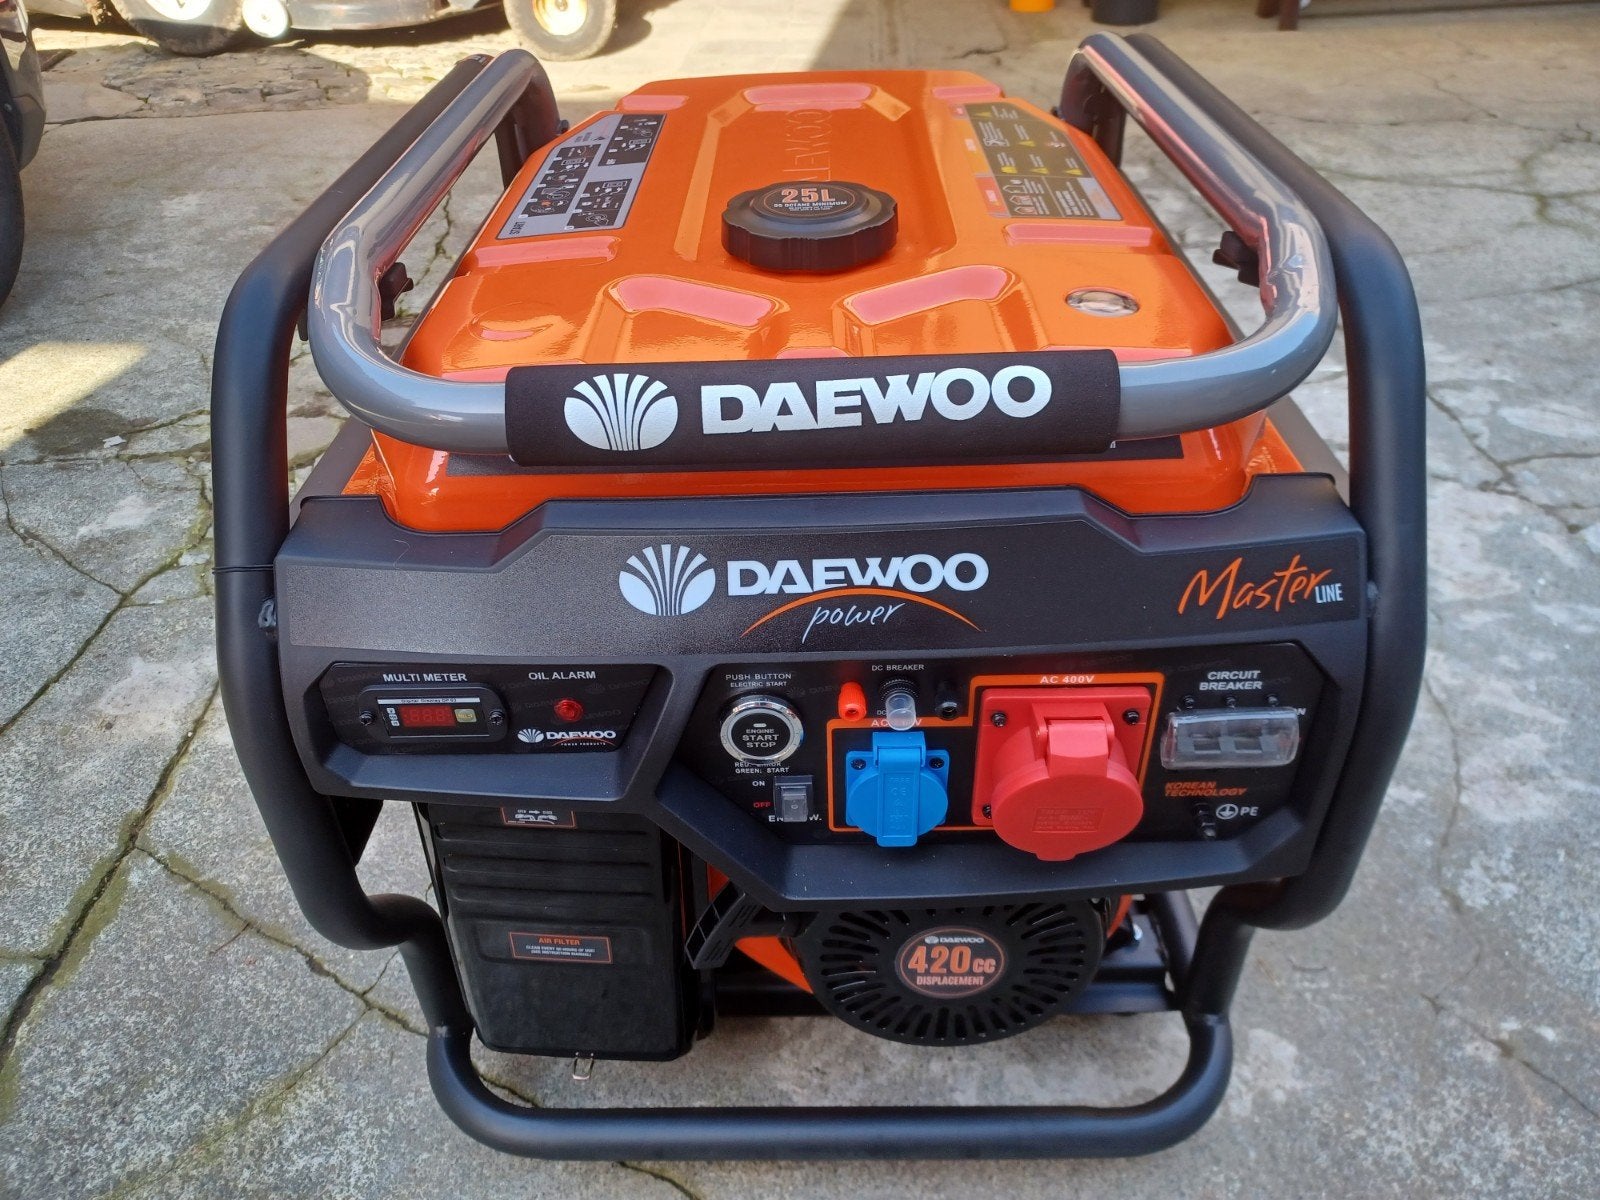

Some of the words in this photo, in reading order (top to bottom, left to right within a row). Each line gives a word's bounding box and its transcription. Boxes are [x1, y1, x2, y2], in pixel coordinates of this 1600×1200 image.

[781, 188, 836, 203] 25L
[700, 364, 1053, 435] DAEWOO
[727, 552, 990, 597] DAEWOO
[1177, 554, 1333, 620] Master
[1315, 583, 1344, 603] LINE
[801, 603, 905, 644] power
[382, 672, 420, 682] MULTI
[423, 672, 468, 682] METER
[528, 672, 549, 680] OIL
[551, 671, 596, 680] ALARM
[725, 673, 751, 681] PUSH
[1040, 676, 1058, 684] AC
[1062, 675, 1095, 684] 400V
[1206, 670, 1261, 680] CIRCUIT
[1199, 681, 1262, 691] BREAKER
[546, 730, 617, 740] DAEWOO
[1165, 781, 1217, 789] KOREAN
[1165, 788, 1247, 797] TECHNOLOGY
[1240, 806, 1259, 816] PE
[554, 938, 580, 946] FILTER
[940, 936, 985, 944] DAEWOO
[916, 976, 985, 986] DISPLACEMENT
